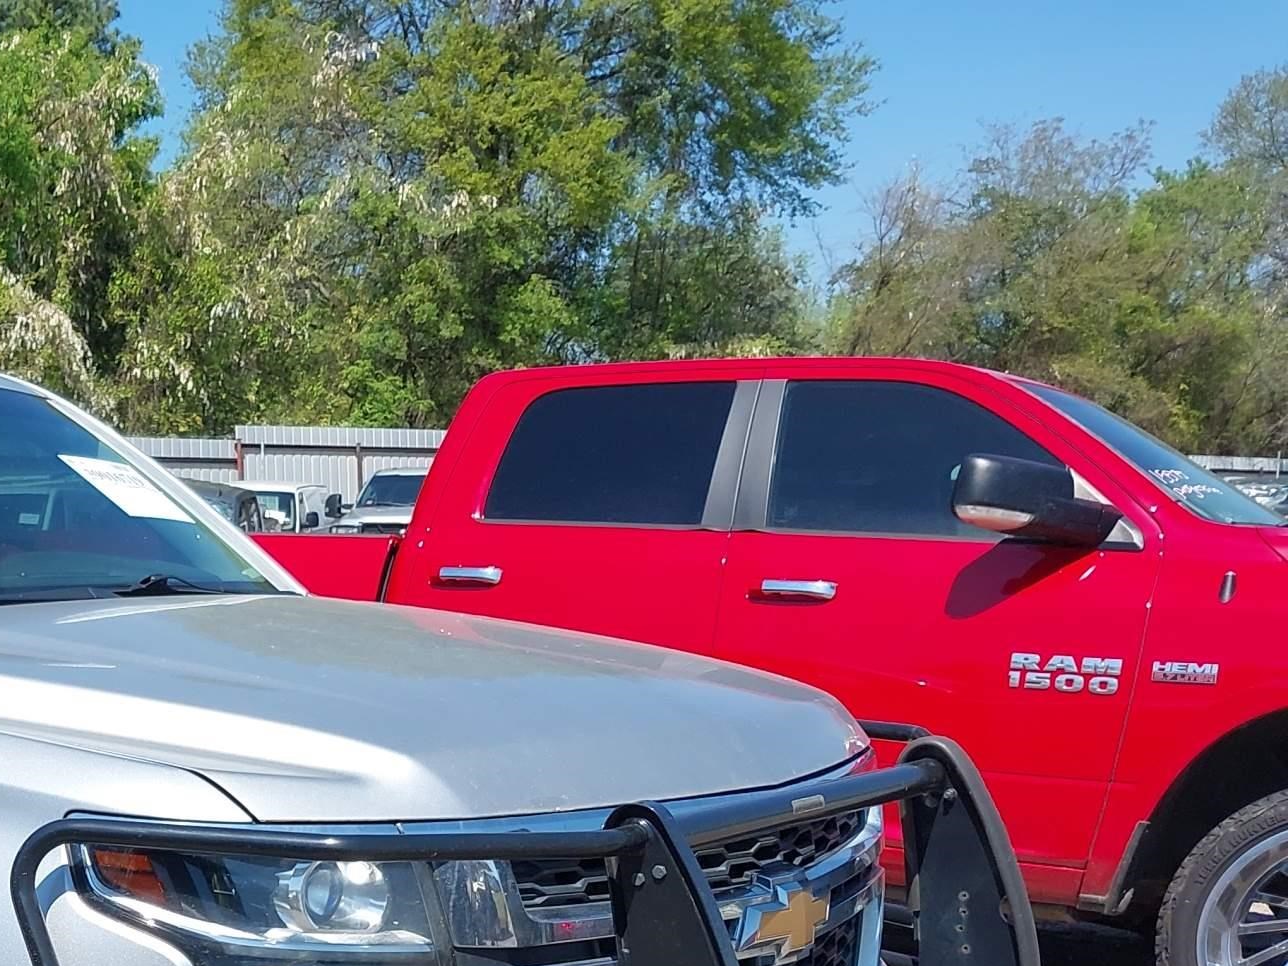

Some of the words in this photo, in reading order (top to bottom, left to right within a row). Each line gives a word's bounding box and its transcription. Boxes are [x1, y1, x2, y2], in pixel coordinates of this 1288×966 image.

[1010, 652, 1123, 676] RAM
[1153, 661, 1219, 675] HEMI
[1008, 670, 1119, 695] 1500
